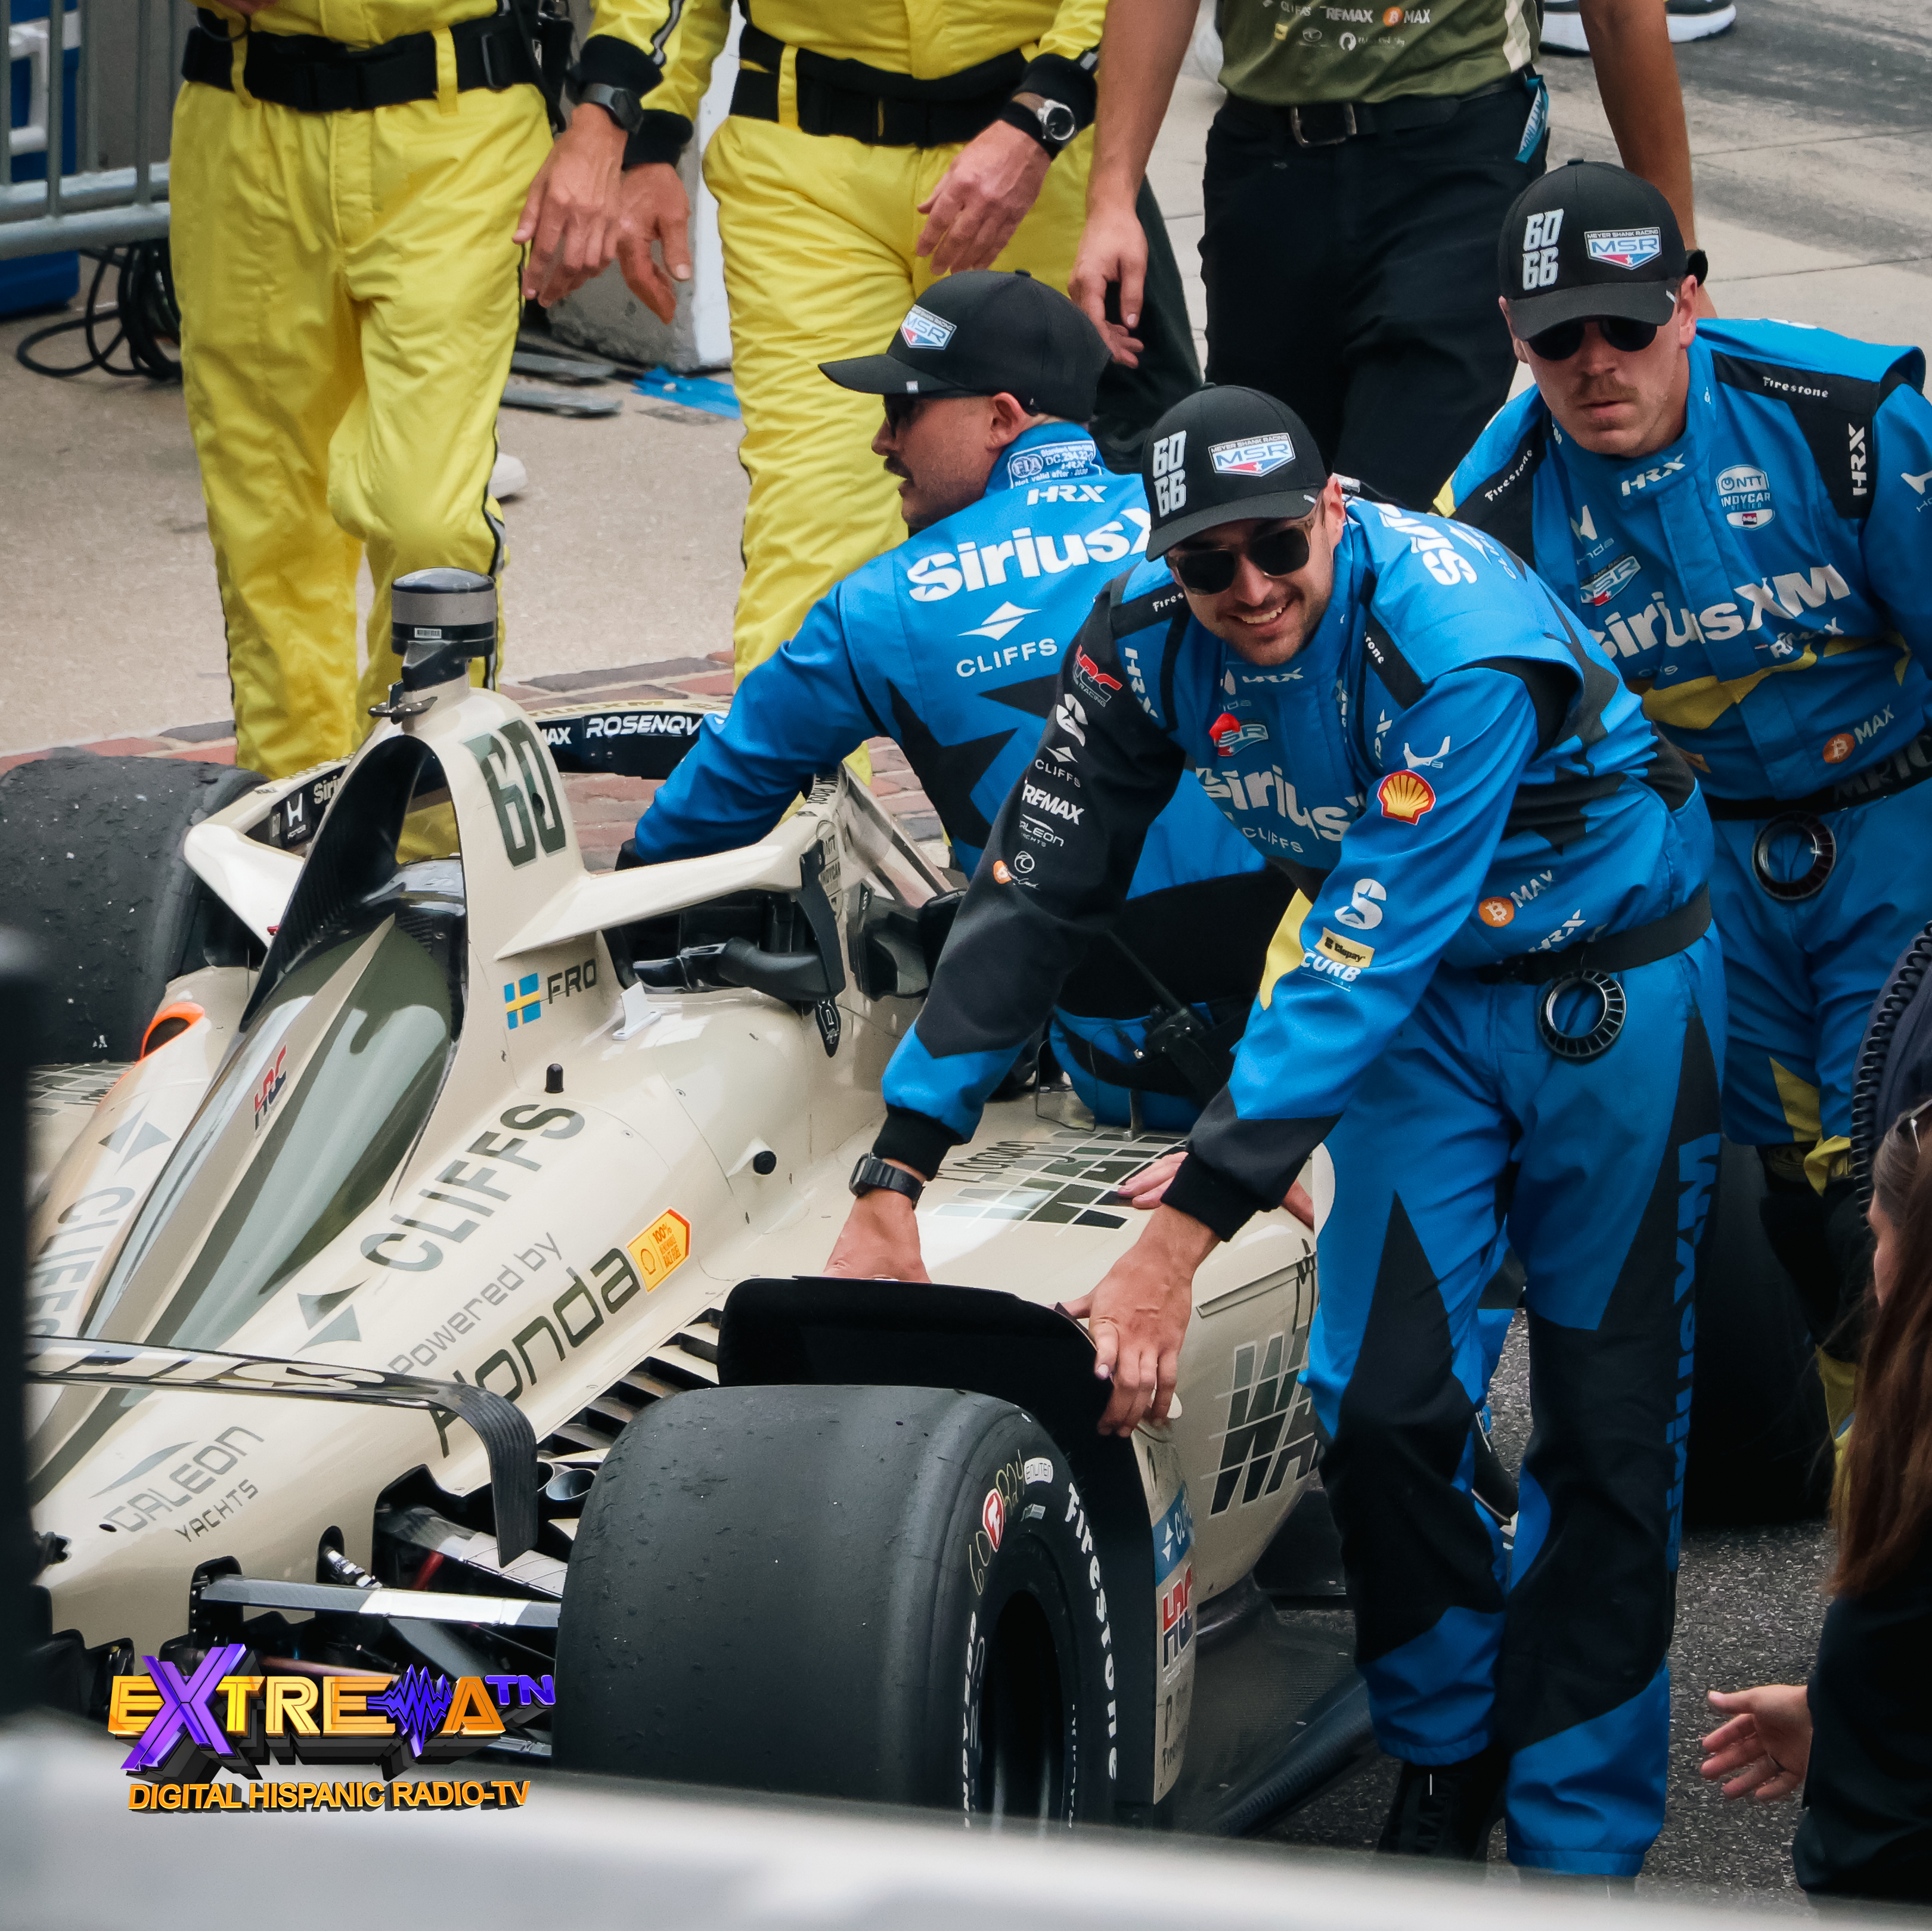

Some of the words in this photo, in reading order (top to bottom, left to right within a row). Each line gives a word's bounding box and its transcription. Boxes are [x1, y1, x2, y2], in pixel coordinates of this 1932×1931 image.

[1404, 9, 1431, 24] MAX
[1524, 209, 1564, 252] 60
[1591, 238, 1658, 253] MSR
[1522, 246, 1559, 291] 66
[904, 313, 947, 344] MSR
[1763, 376, 1828, 399] Firestone
[1153, 430, 1187, 479] 60
[1211, 443, 1236, 454] MEYER
[1237, 439, 1263, 448] SHANK
[1263, 434, 1288, 444] RACING
[1216, 443, 1288, 467] MSR
[1849, 423, 1868, 496] HRX
[1027, 484, 1108, 506] HRX
[1153, 469, 1186, 517] 66
[1485, 449, 1533, 502] Firestone
[1621, 453, 1686, 496] HRX
[1736, 476, 1762, 488] NTT
[1721, 492, 1770, 508] INDYCAR
[956, 638, 1058, 678] CLIFFS
[1365, 632, 1384, 664] tone
[1854, 703, 1894, 745] MAX
[461, 717, 566, 870] 60
[1035, 759, 1081, 789] CLIFFS
[1021, 781, 1086, 826] REMAX
[1195, 764, 1362, 842] Sirius
[1242, 827, 1304, 853] CLIFFS
[547, 958, 596, 1004] FRO
[1300, 952, 1367, 982] CURB
[359, 1103, 585, 1273] CLIFFS
[514, 1232, 562, 1272] by
[652, 1222, 672, 1244] 100%
[103, 1425, 265, 1533] GALEON
[174, 1478, 259, 1542] YACHTS
[1065, 1482, 1118, 1781] Firestone
